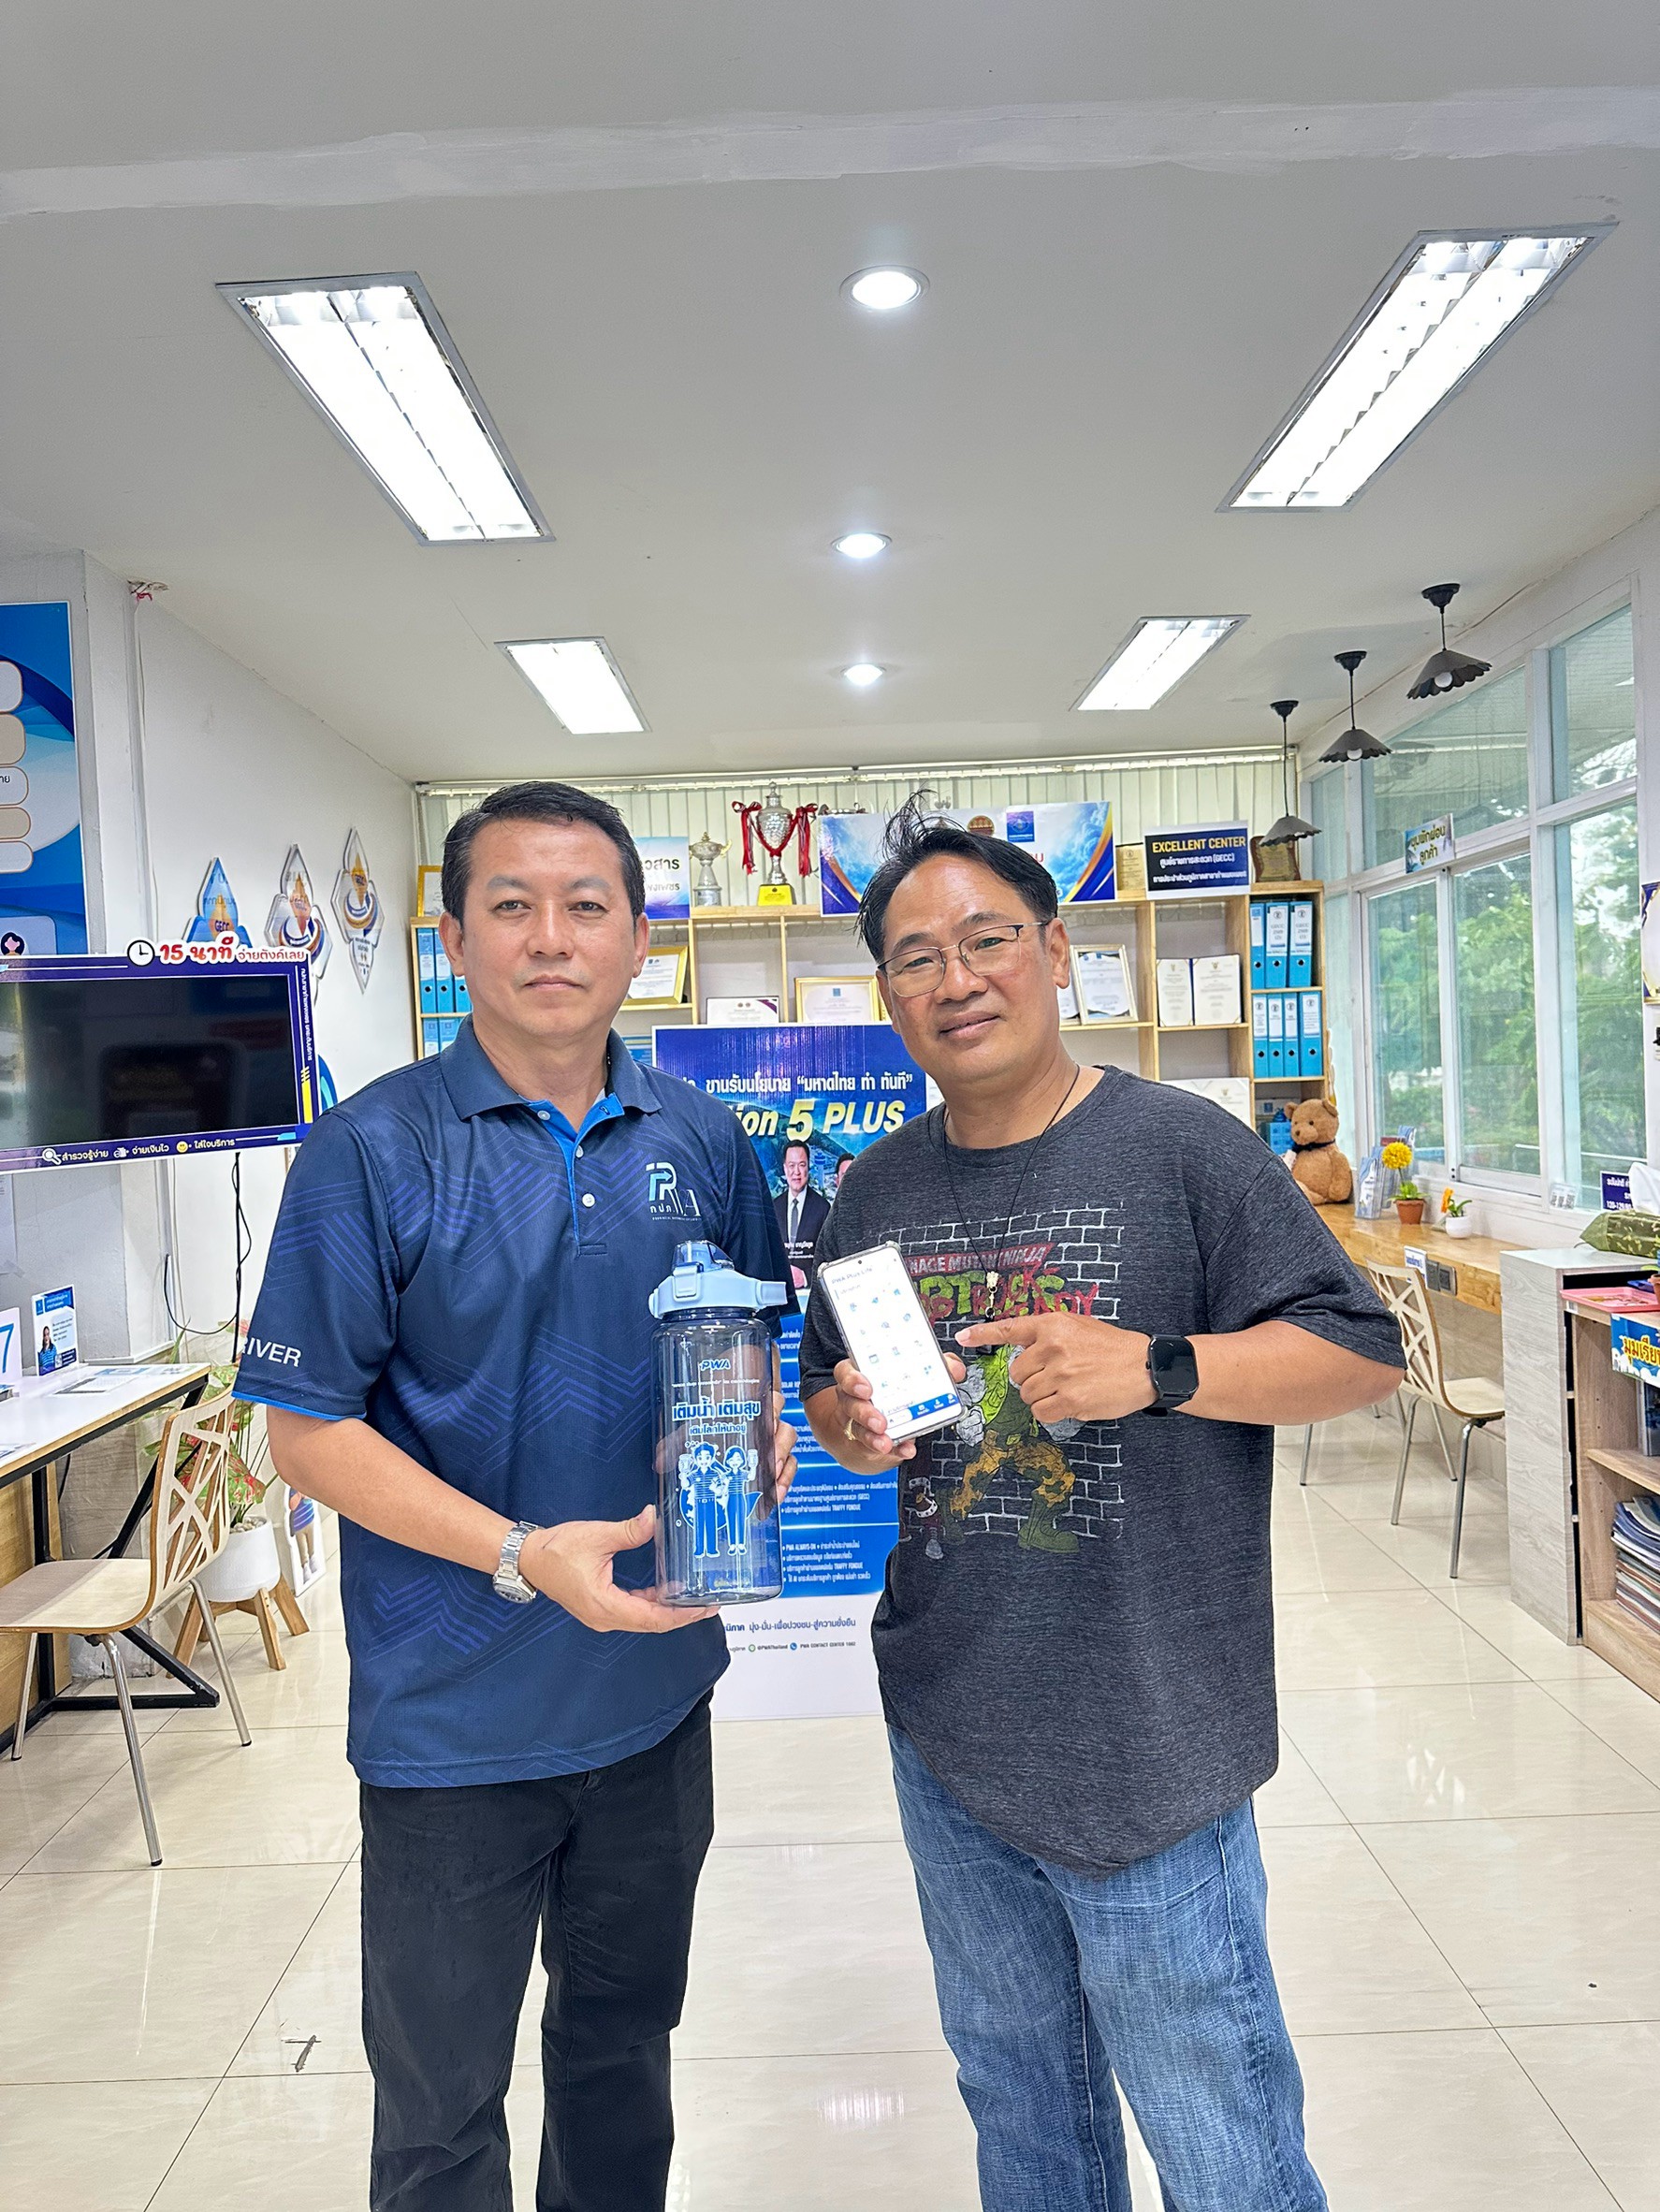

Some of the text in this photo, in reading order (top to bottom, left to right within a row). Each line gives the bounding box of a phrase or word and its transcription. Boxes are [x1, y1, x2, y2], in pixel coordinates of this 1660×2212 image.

[1152, 836, 1246, 853] EXCELLENT CENTER
[160, 936, 305, 961] 15 นาที จ่ายตังค์เลย
[706, 1071, 792, 1094] ขานรับนโยบาย
[796, 1070, 856, 1092] “มหาดไทย
[861, 1071, 876, 1091] ทำ
[785, 1099, 816, 1143] 5
[822, 1099, 907, 1134] PLUS
[132, 1143, 170, 1157] จ่ายเงินไว
[194, 1138, 235, 1151] ใส่ใจบริการ
[909, 1256, 947, 1274] NAGE
[999, 1245, 1047, 1266] NINJA
[0, 1323, 14, 1374] 7
[700, 1359, 731, 1371] PWA
[672, 1396, 761, 1421] เติมน้ำ เติมสุข
[689, 1422, 747, 1435] เติมโลกให้น่าอยู่
